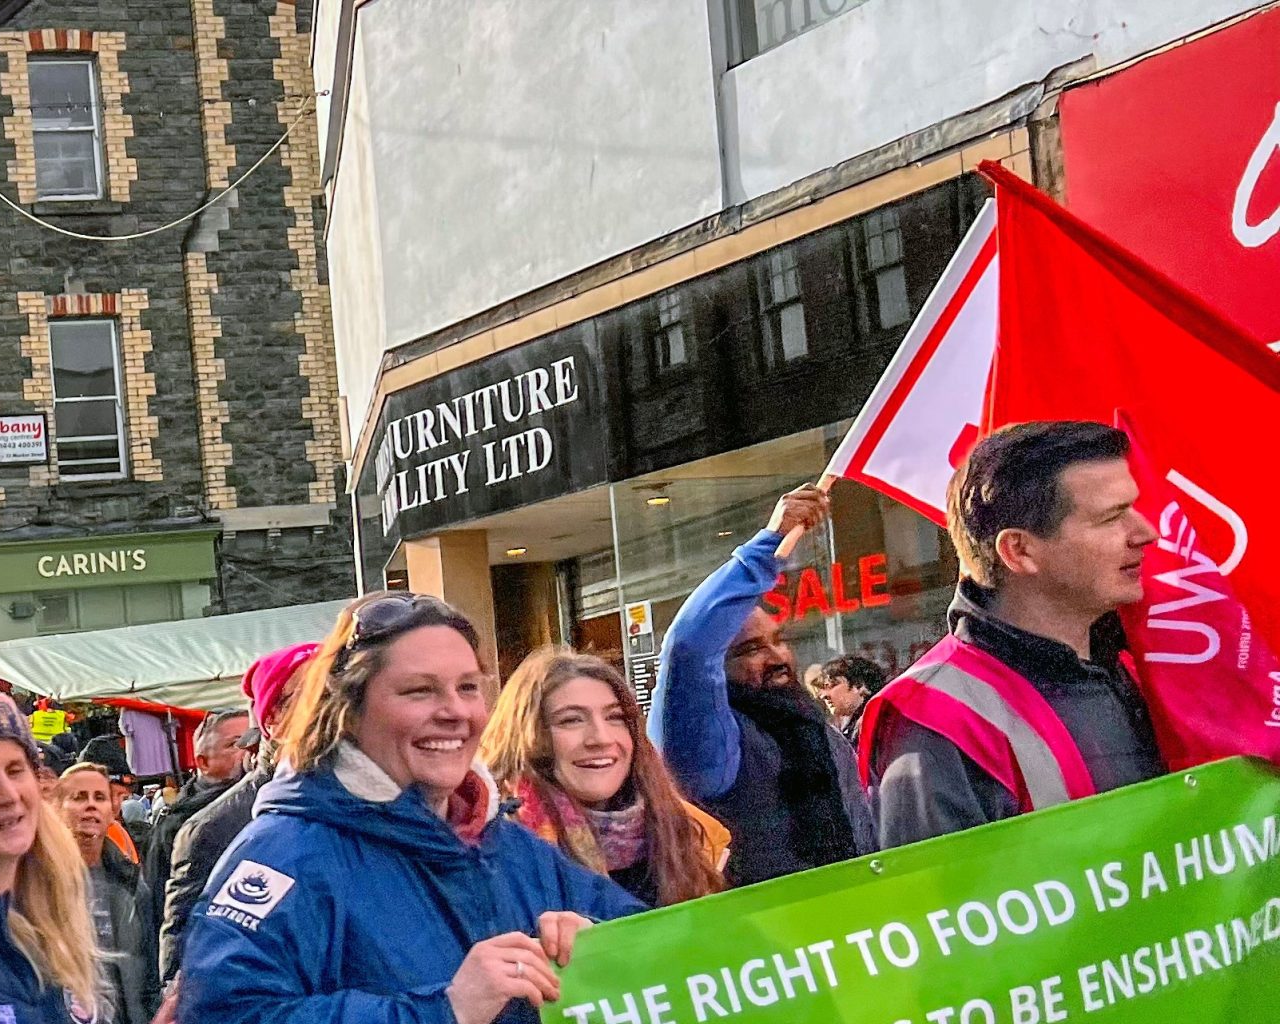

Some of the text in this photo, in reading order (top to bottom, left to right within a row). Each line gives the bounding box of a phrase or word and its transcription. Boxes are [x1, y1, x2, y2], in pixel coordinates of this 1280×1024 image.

[482, 427, 553, 486] LTD
[37, 549, 147, 578] CARINI'S
[762, 553, 892, 624] SALE
[846, 921, 920, 976] TO
[927, 878, 1077, 956] FOOD
[1085, 861, 1130, 913] IS
[1141, 851, 1169, 899] A
[1174, 815, 1280, 886] HUM
